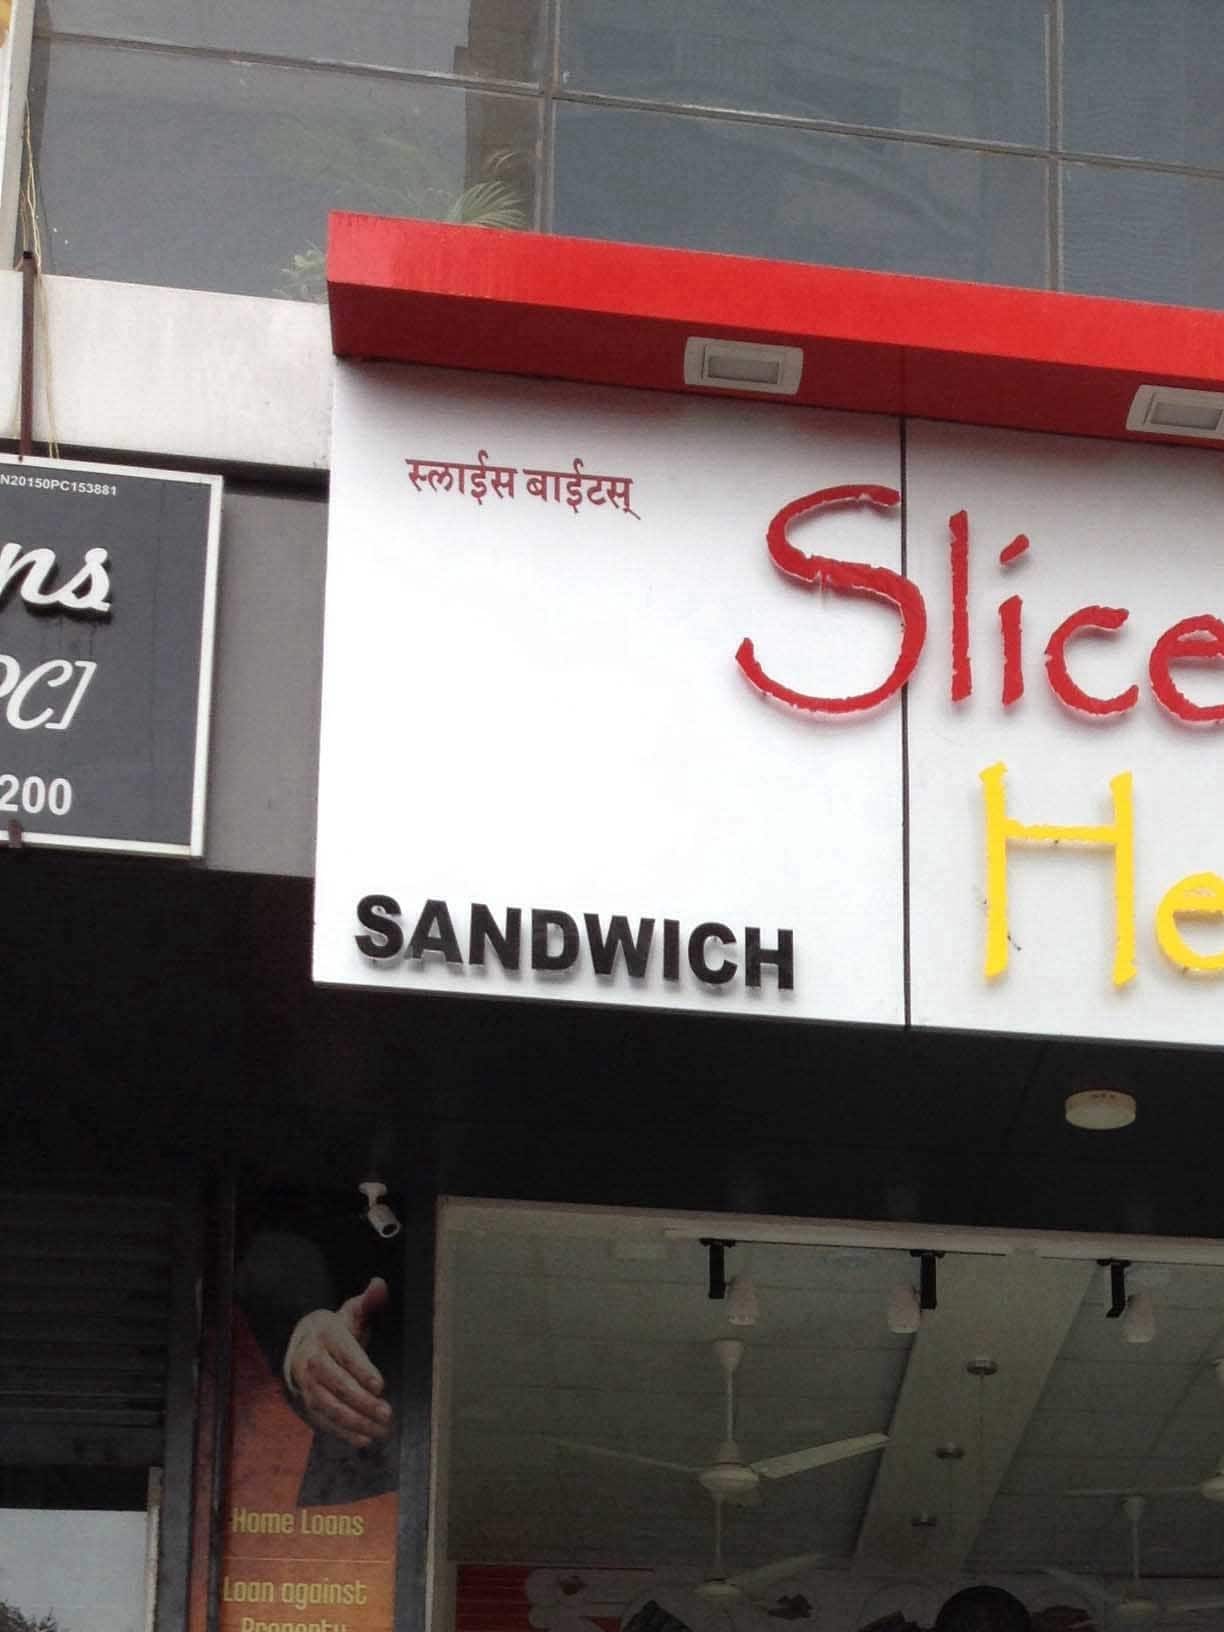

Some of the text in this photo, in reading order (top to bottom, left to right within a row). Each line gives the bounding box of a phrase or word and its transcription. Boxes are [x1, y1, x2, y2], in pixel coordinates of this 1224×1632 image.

[354, 893, 796, 991] SANDWICH
[232, 1507, 365, 1536] Home Loans
[223, 1576, 367, 1610] Loan against
